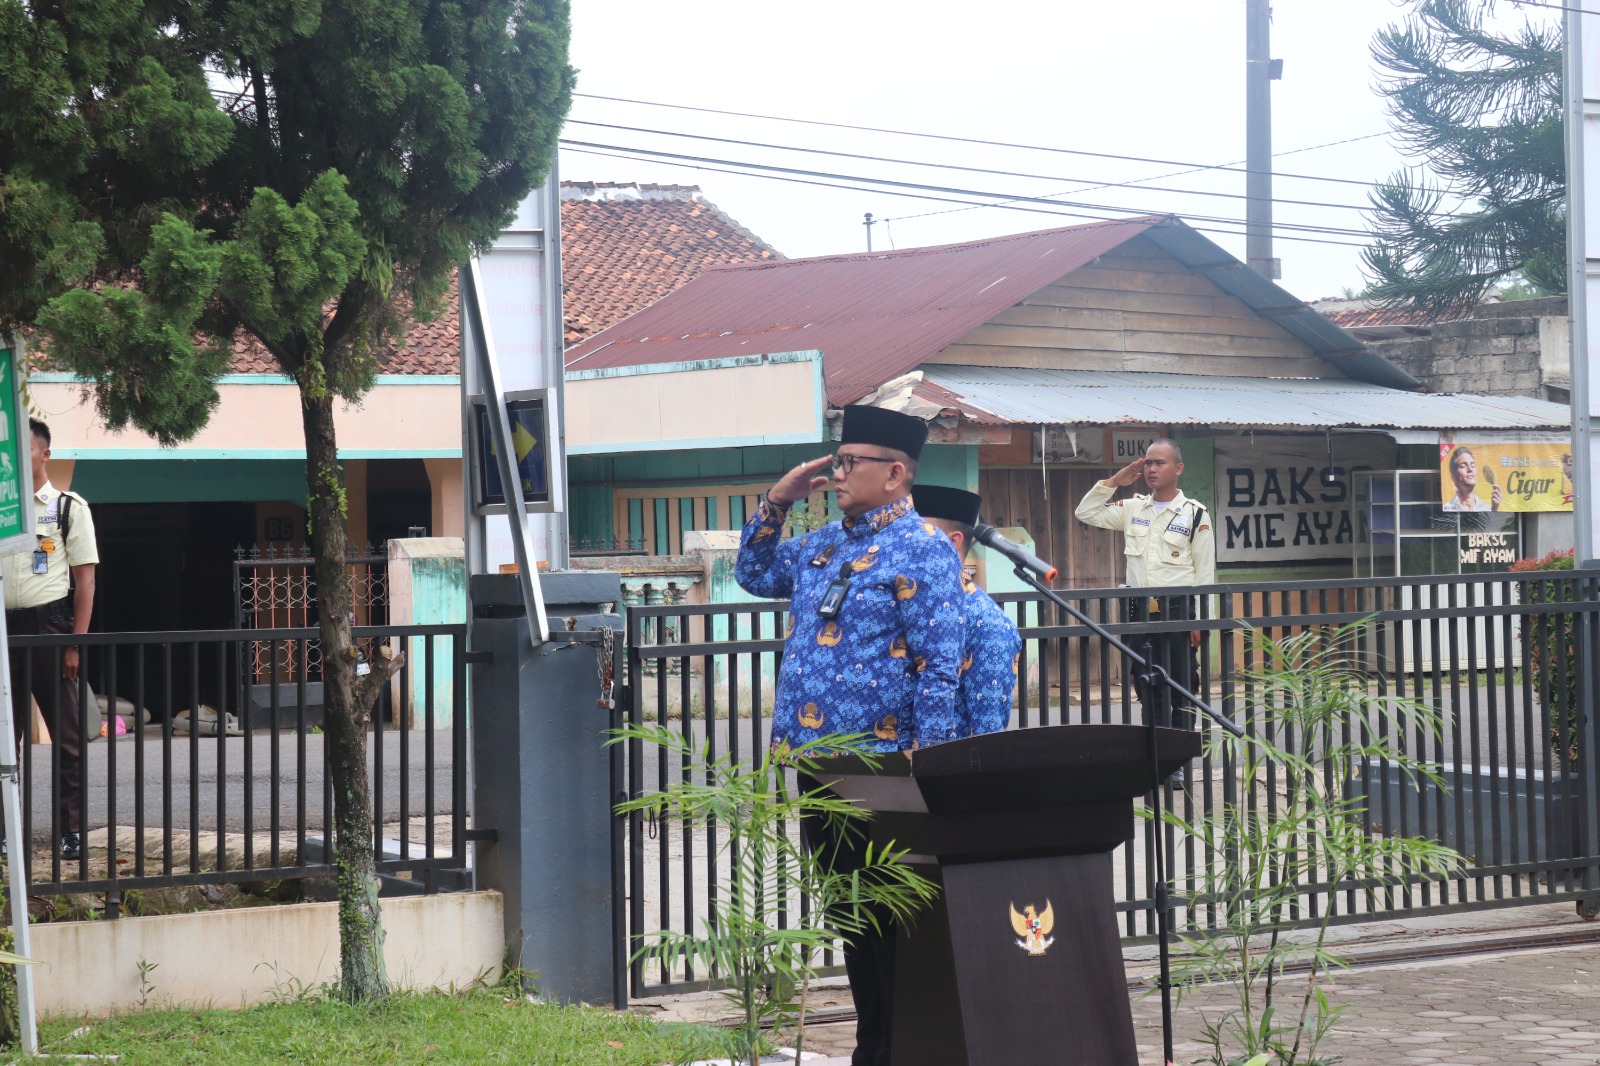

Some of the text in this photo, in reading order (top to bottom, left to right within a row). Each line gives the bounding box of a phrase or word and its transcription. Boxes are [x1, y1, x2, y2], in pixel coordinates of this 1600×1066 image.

[0, 479, 18, 502] PUL
[1226, 465, 1374, 507] BAKS
[1507, 470, 1555, 501] Cigar
[1225, 513, 1286, 549] MIE
[1483, 548, 1515, 563] AYAM
